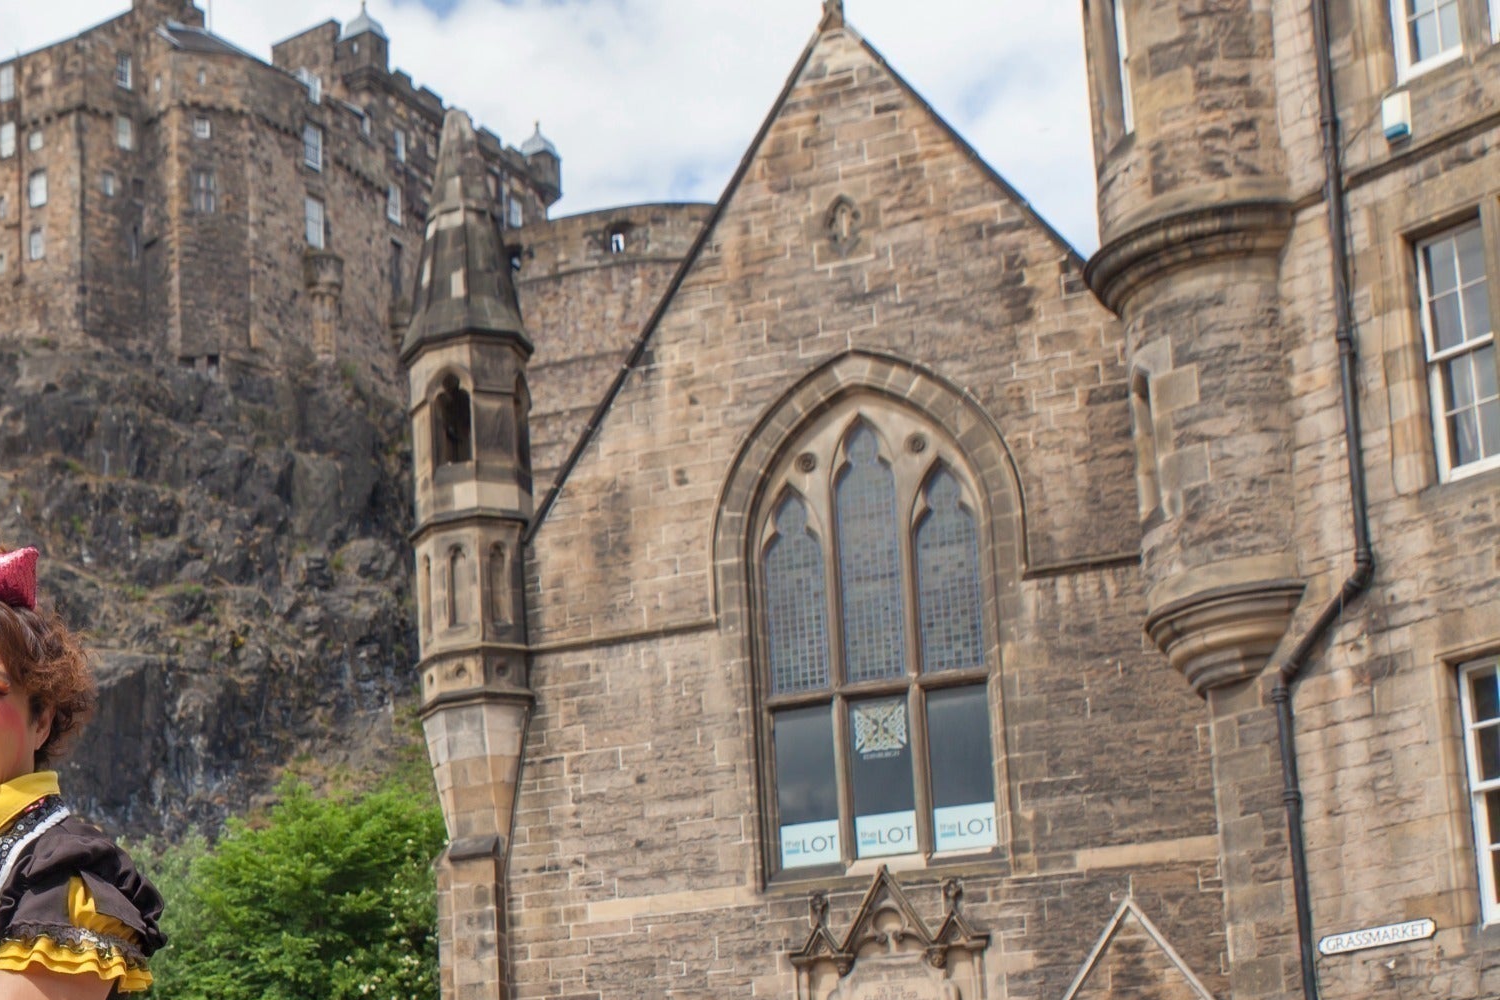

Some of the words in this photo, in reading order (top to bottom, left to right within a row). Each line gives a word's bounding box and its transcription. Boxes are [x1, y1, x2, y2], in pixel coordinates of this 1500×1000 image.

[877, 826, 913, 845] LOT
[957, 817, 993, 837] LOT
[801, 834, 836, 853] LOT
[1326, 922, 1428, 952] GRASSMARKET
